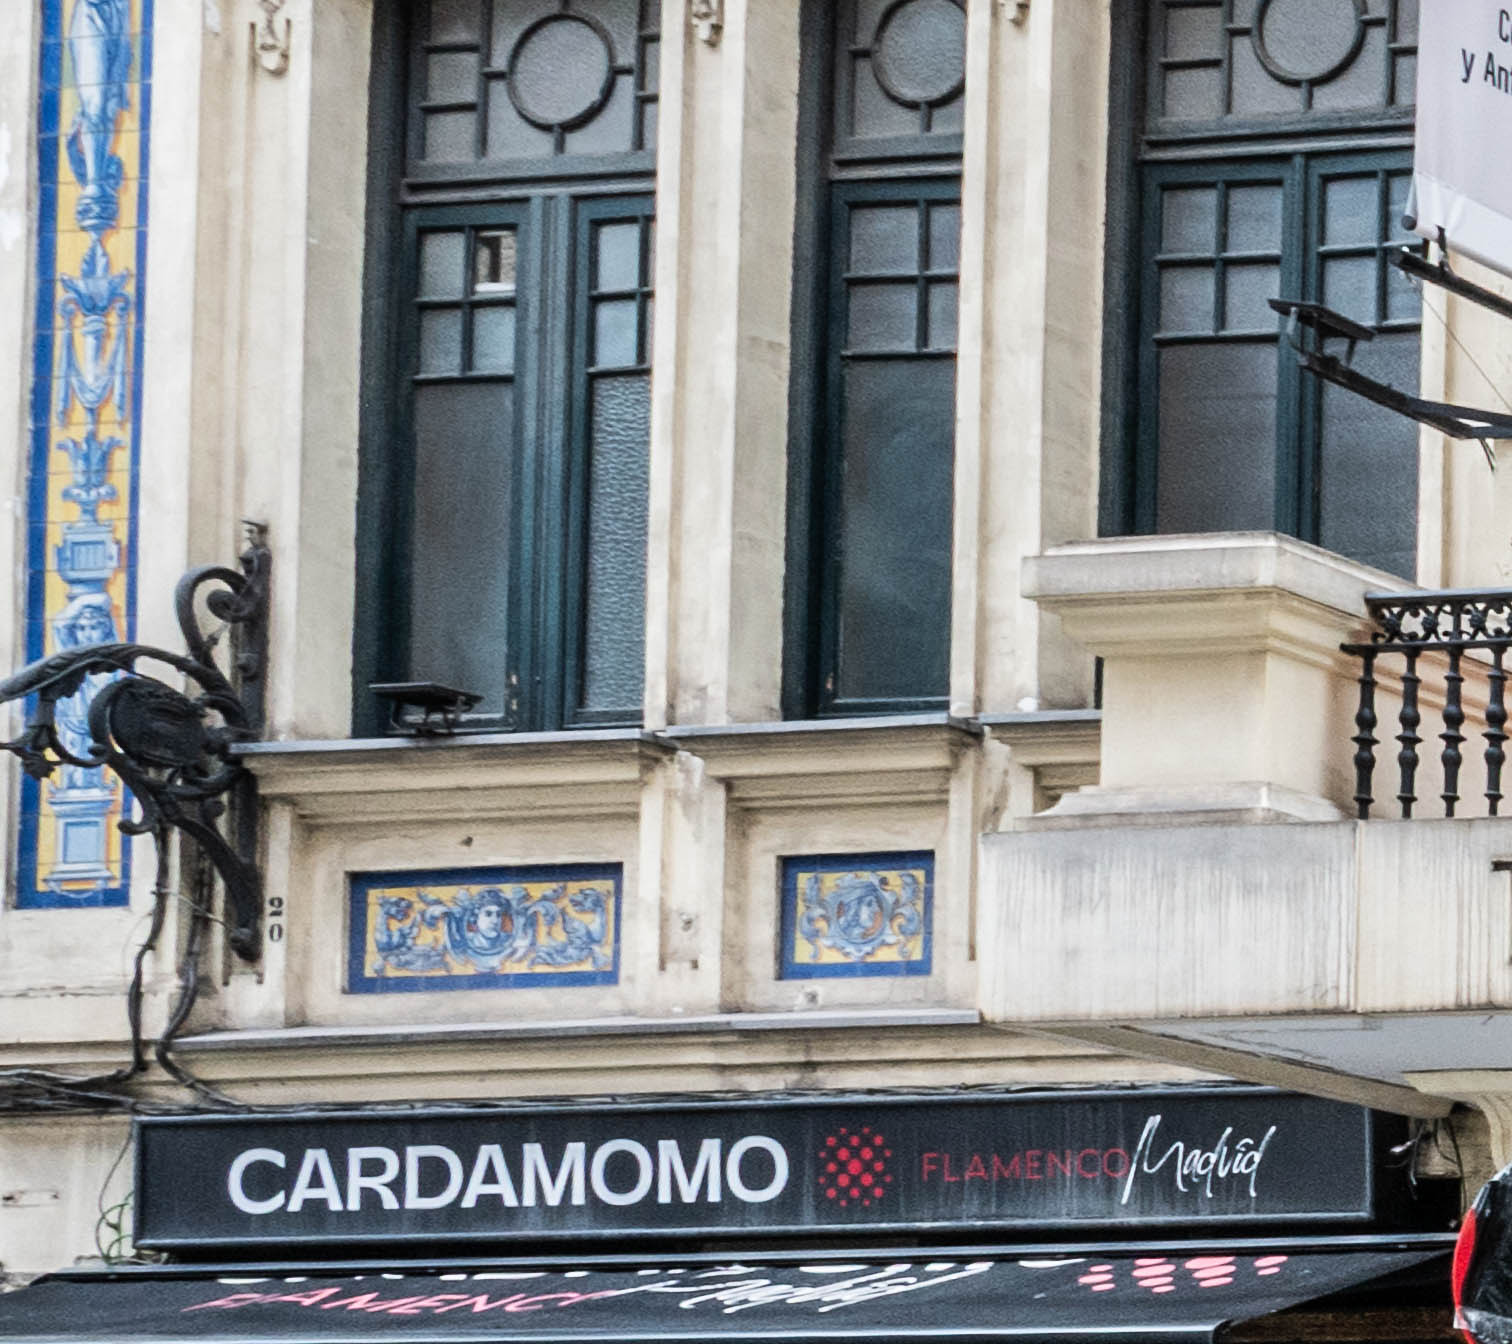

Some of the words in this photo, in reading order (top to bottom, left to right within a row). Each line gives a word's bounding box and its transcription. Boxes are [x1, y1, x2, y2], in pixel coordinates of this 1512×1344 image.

[1461, 48, 1475, 83] y
[227, 1137, 789, 1215] CARDAMOMO
[919, 1146, 1128, 1185] FLAMENCO
